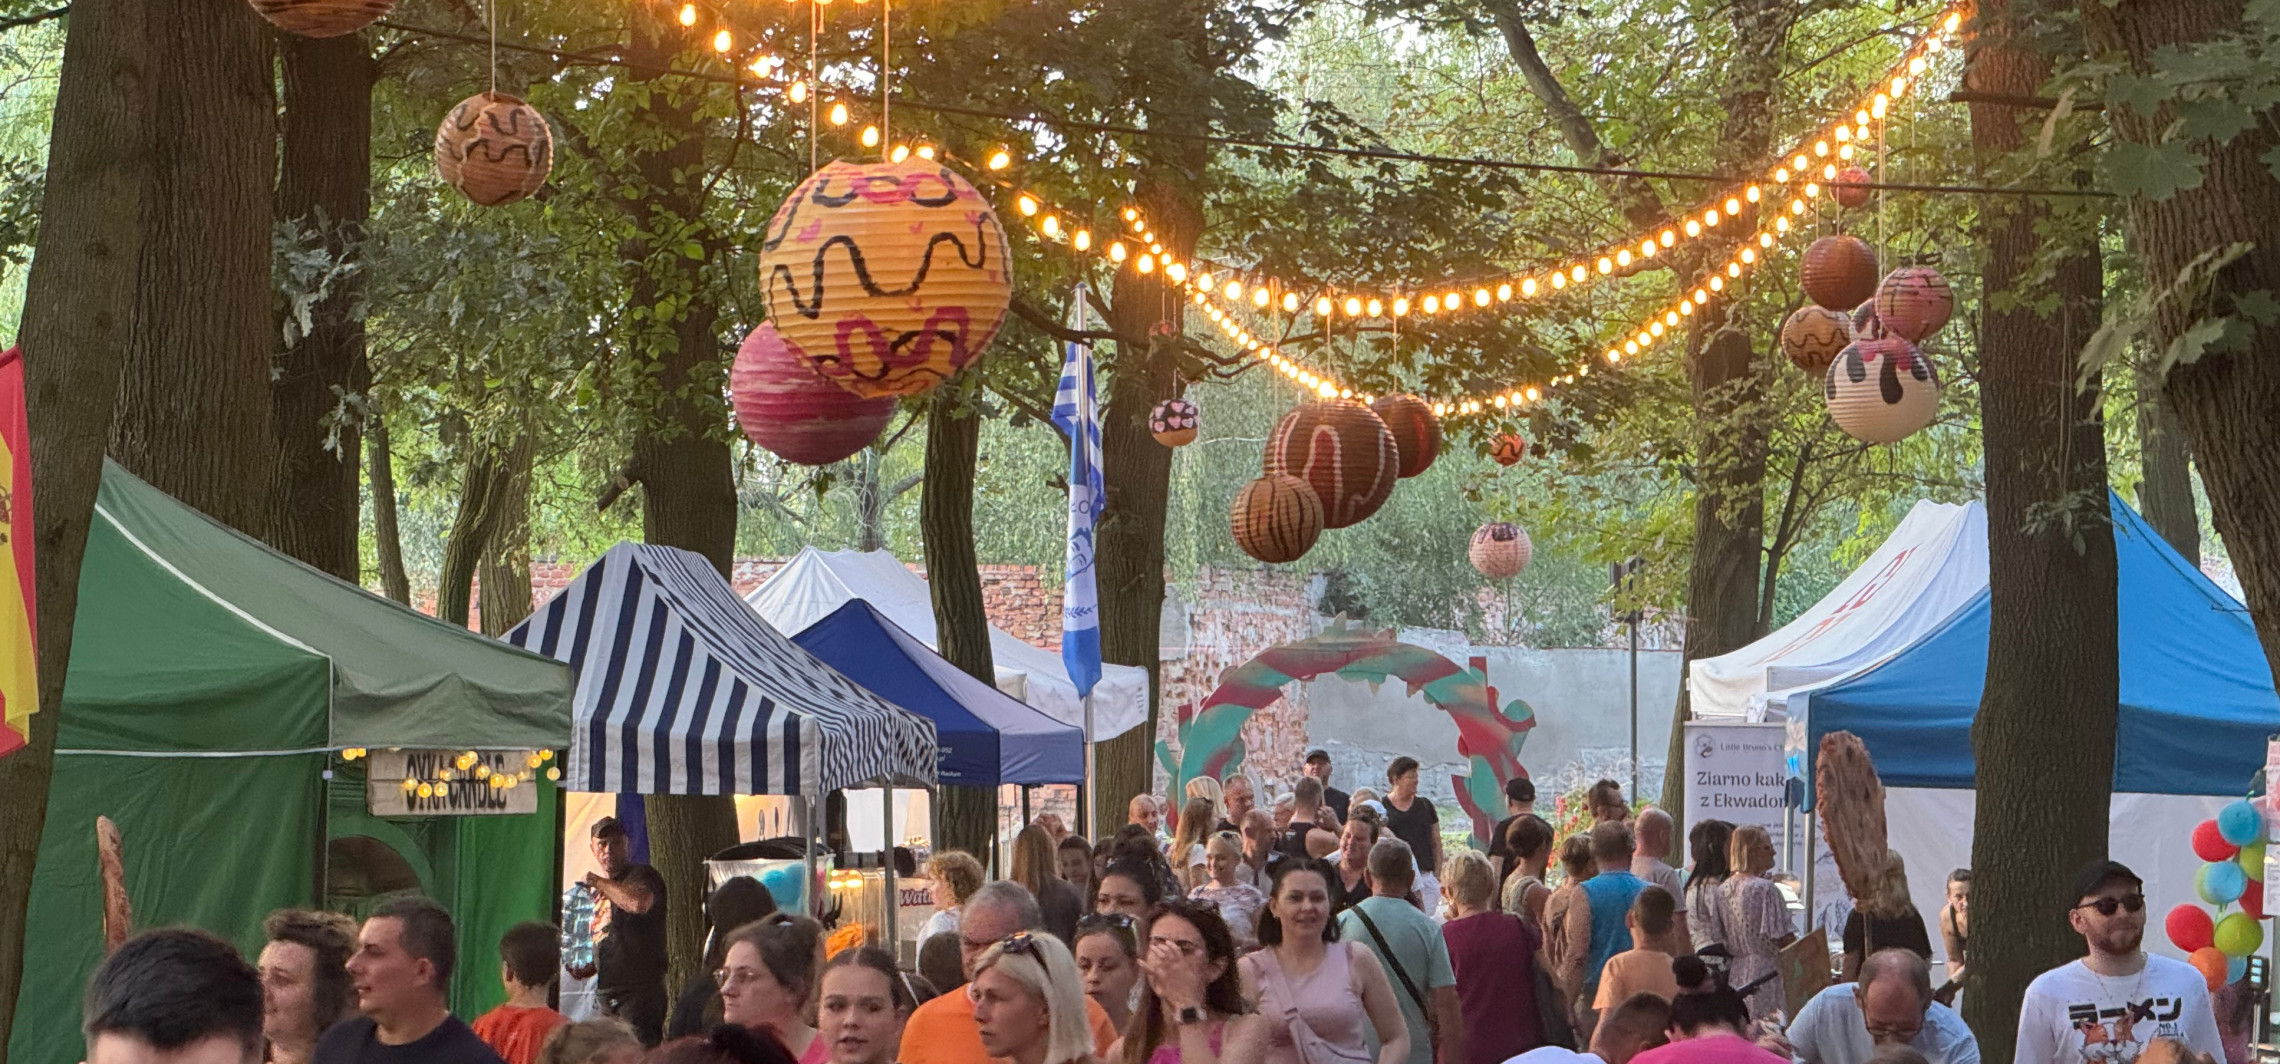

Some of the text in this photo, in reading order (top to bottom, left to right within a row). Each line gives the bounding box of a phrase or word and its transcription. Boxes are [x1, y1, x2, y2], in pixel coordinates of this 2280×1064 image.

[1720, 743, 1740, 751] Little
[1743, 743, 1772, 751] Bruno's
[1697, 771, 1785, 787] Ziarno kak
[1701, 796, 1710, 808] z
[2069, 997, 2182, 1030] ラーメン
